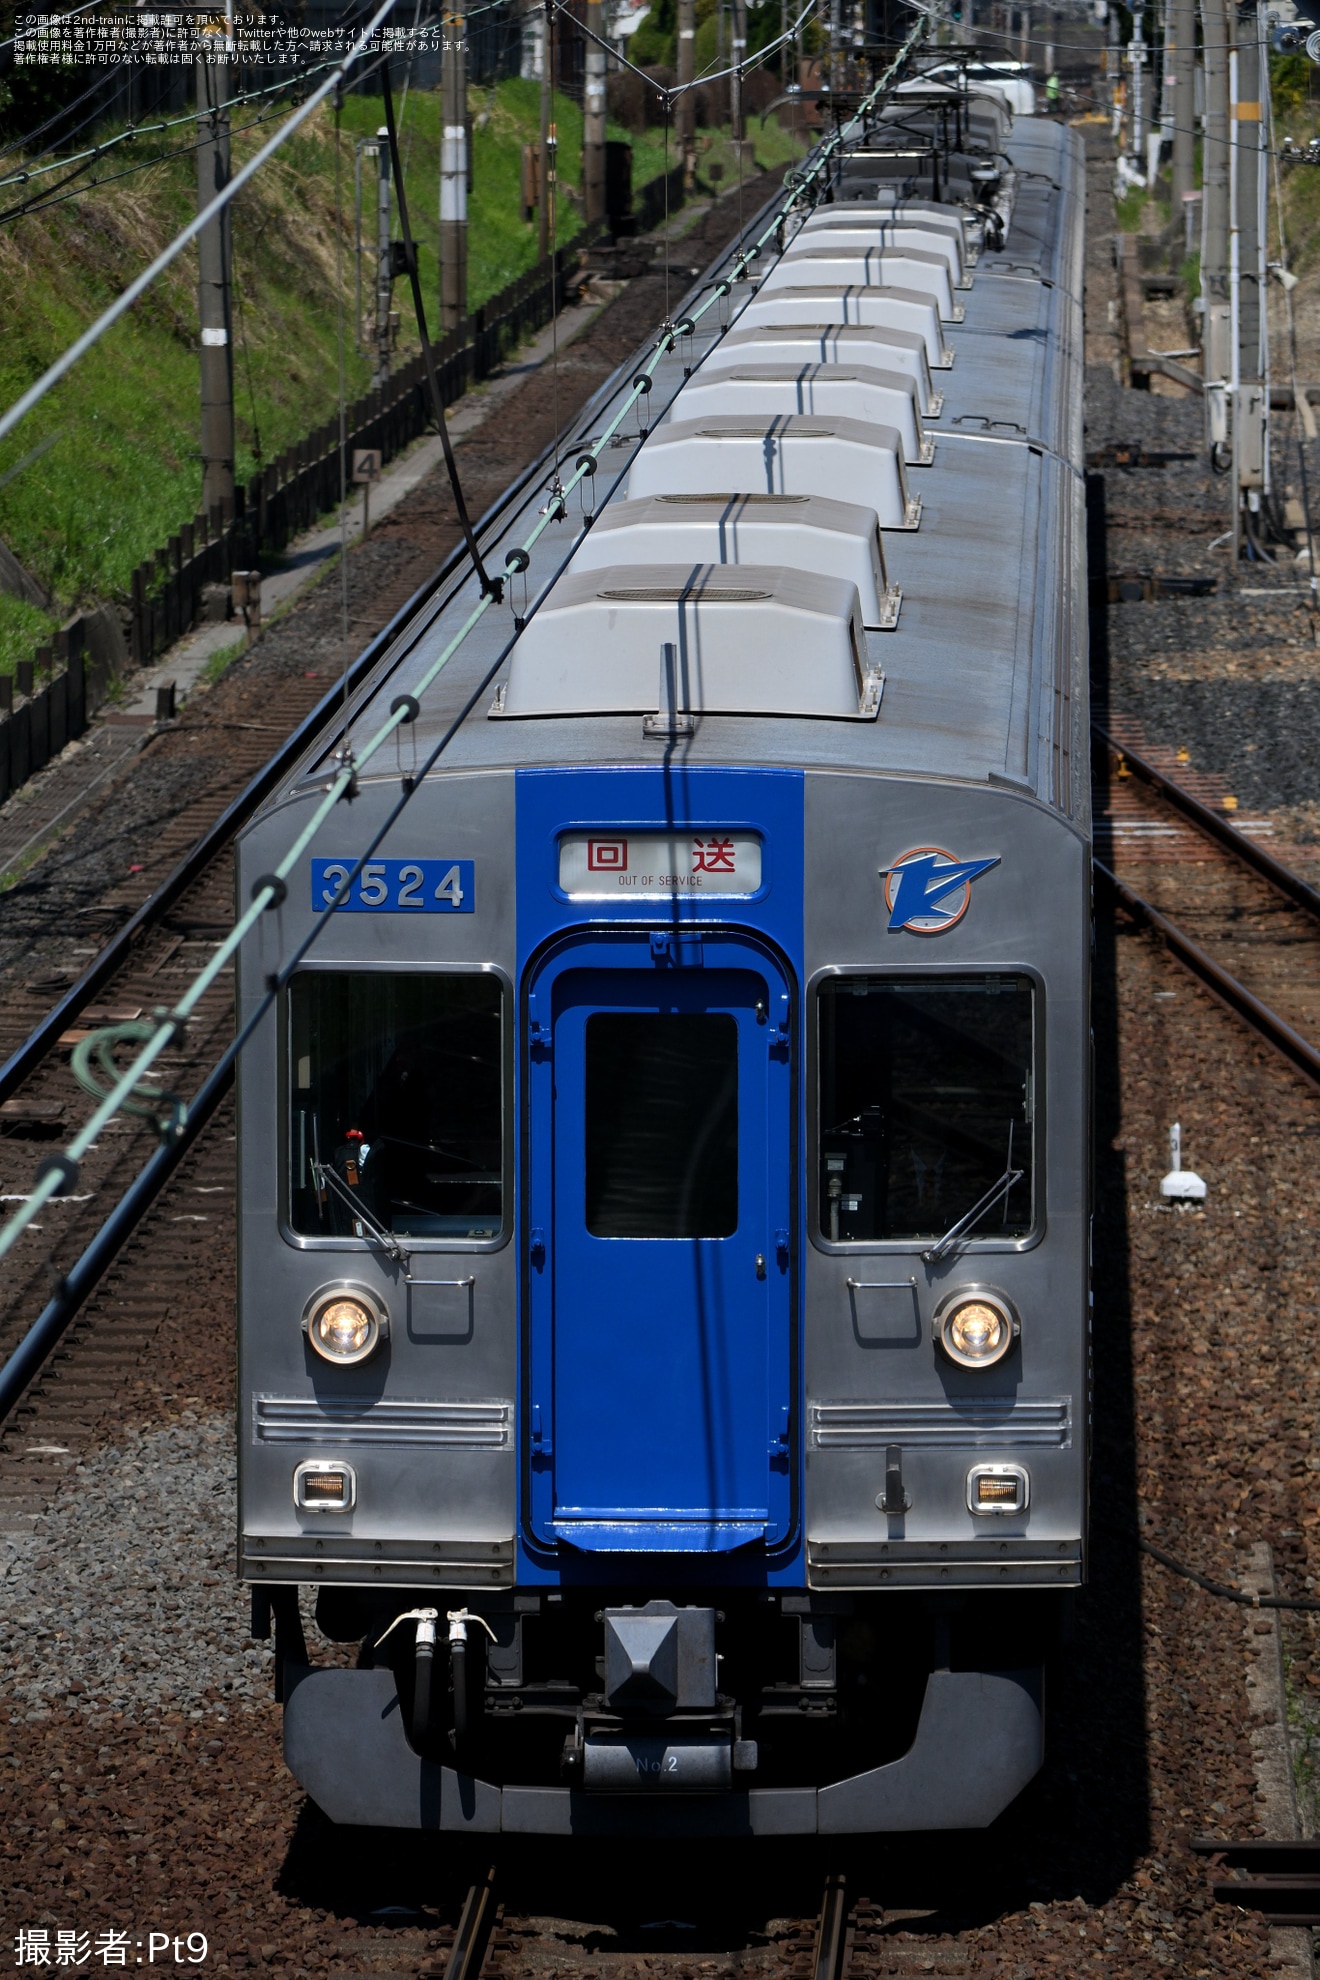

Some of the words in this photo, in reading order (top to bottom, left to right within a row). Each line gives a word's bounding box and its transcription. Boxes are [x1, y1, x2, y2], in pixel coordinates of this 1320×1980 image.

[357, 453, 378, 478] 4
[588, 838, 735, 873] 回送
[322, 864, 464, 907] 3524
[618, 876, 638, 886] OUT
[641, 876, 654, 886] OF
[658, 876, 703, 887] SERVICE
[636, 1756, 678, 1772] No.2
